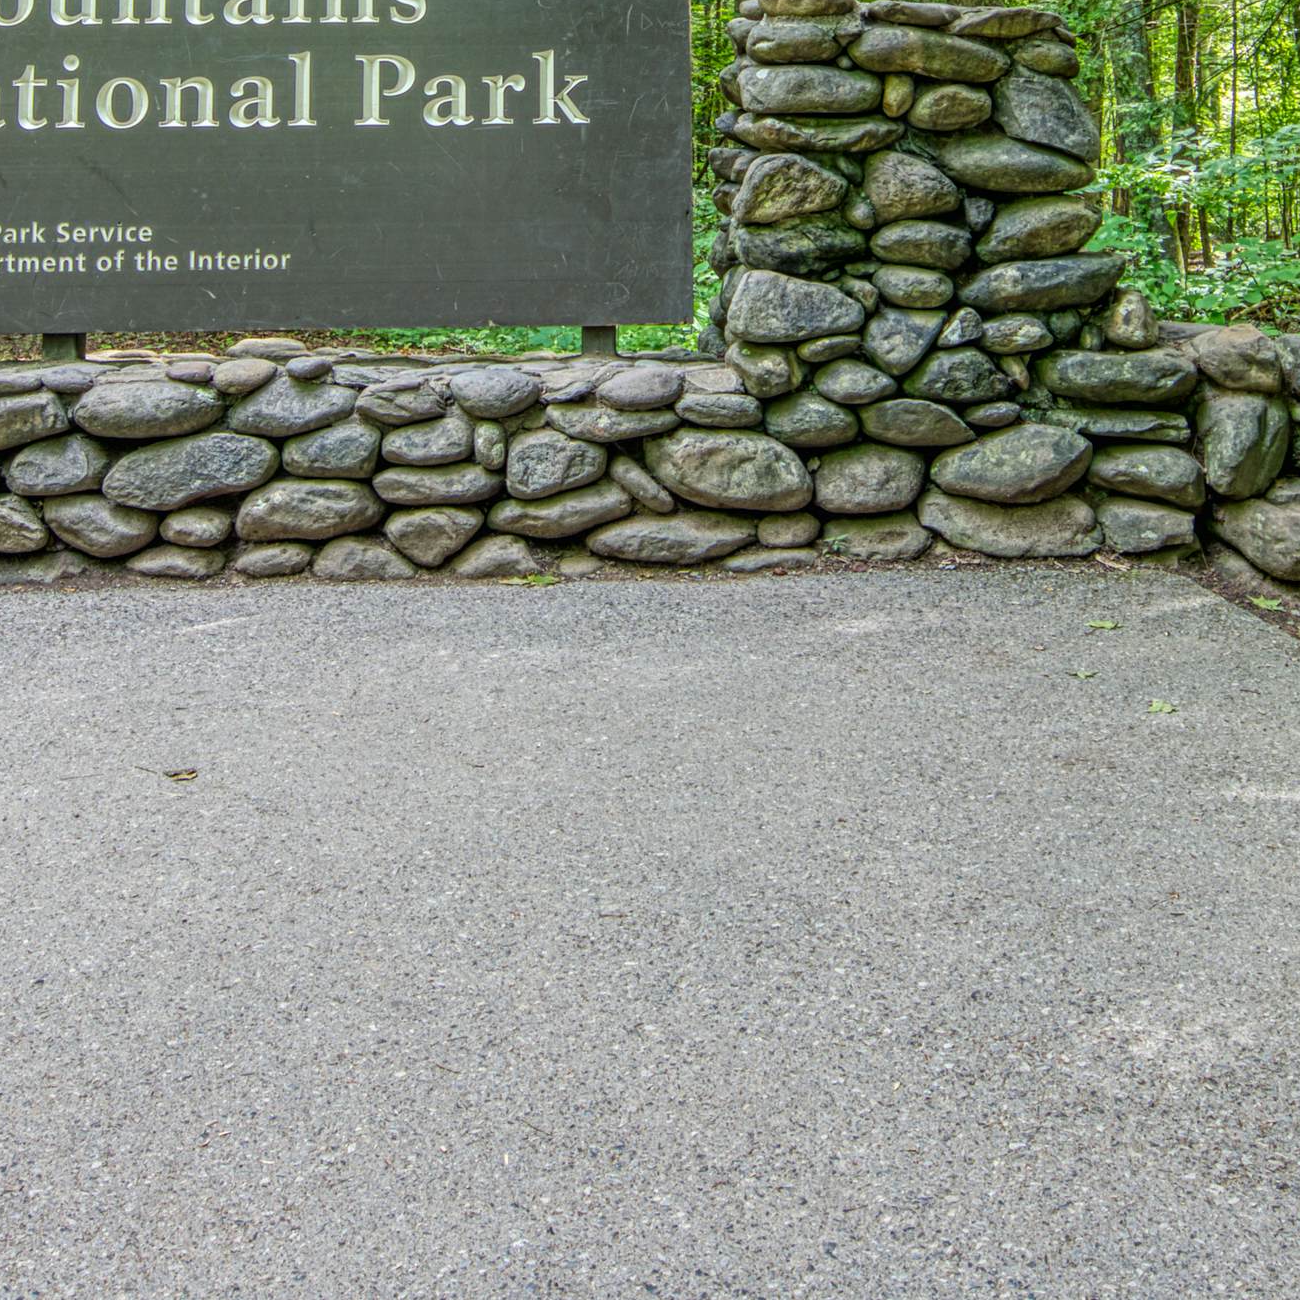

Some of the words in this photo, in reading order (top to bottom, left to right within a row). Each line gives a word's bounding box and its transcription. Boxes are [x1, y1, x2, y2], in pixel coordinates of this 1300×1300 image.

[354, 49, 591, 127] Park
[56, 221, 153, 243] Service
[96, 249, 125, 272] of
[133, 249, 178, 272] the
[189, 248, 291, 271] Interior
